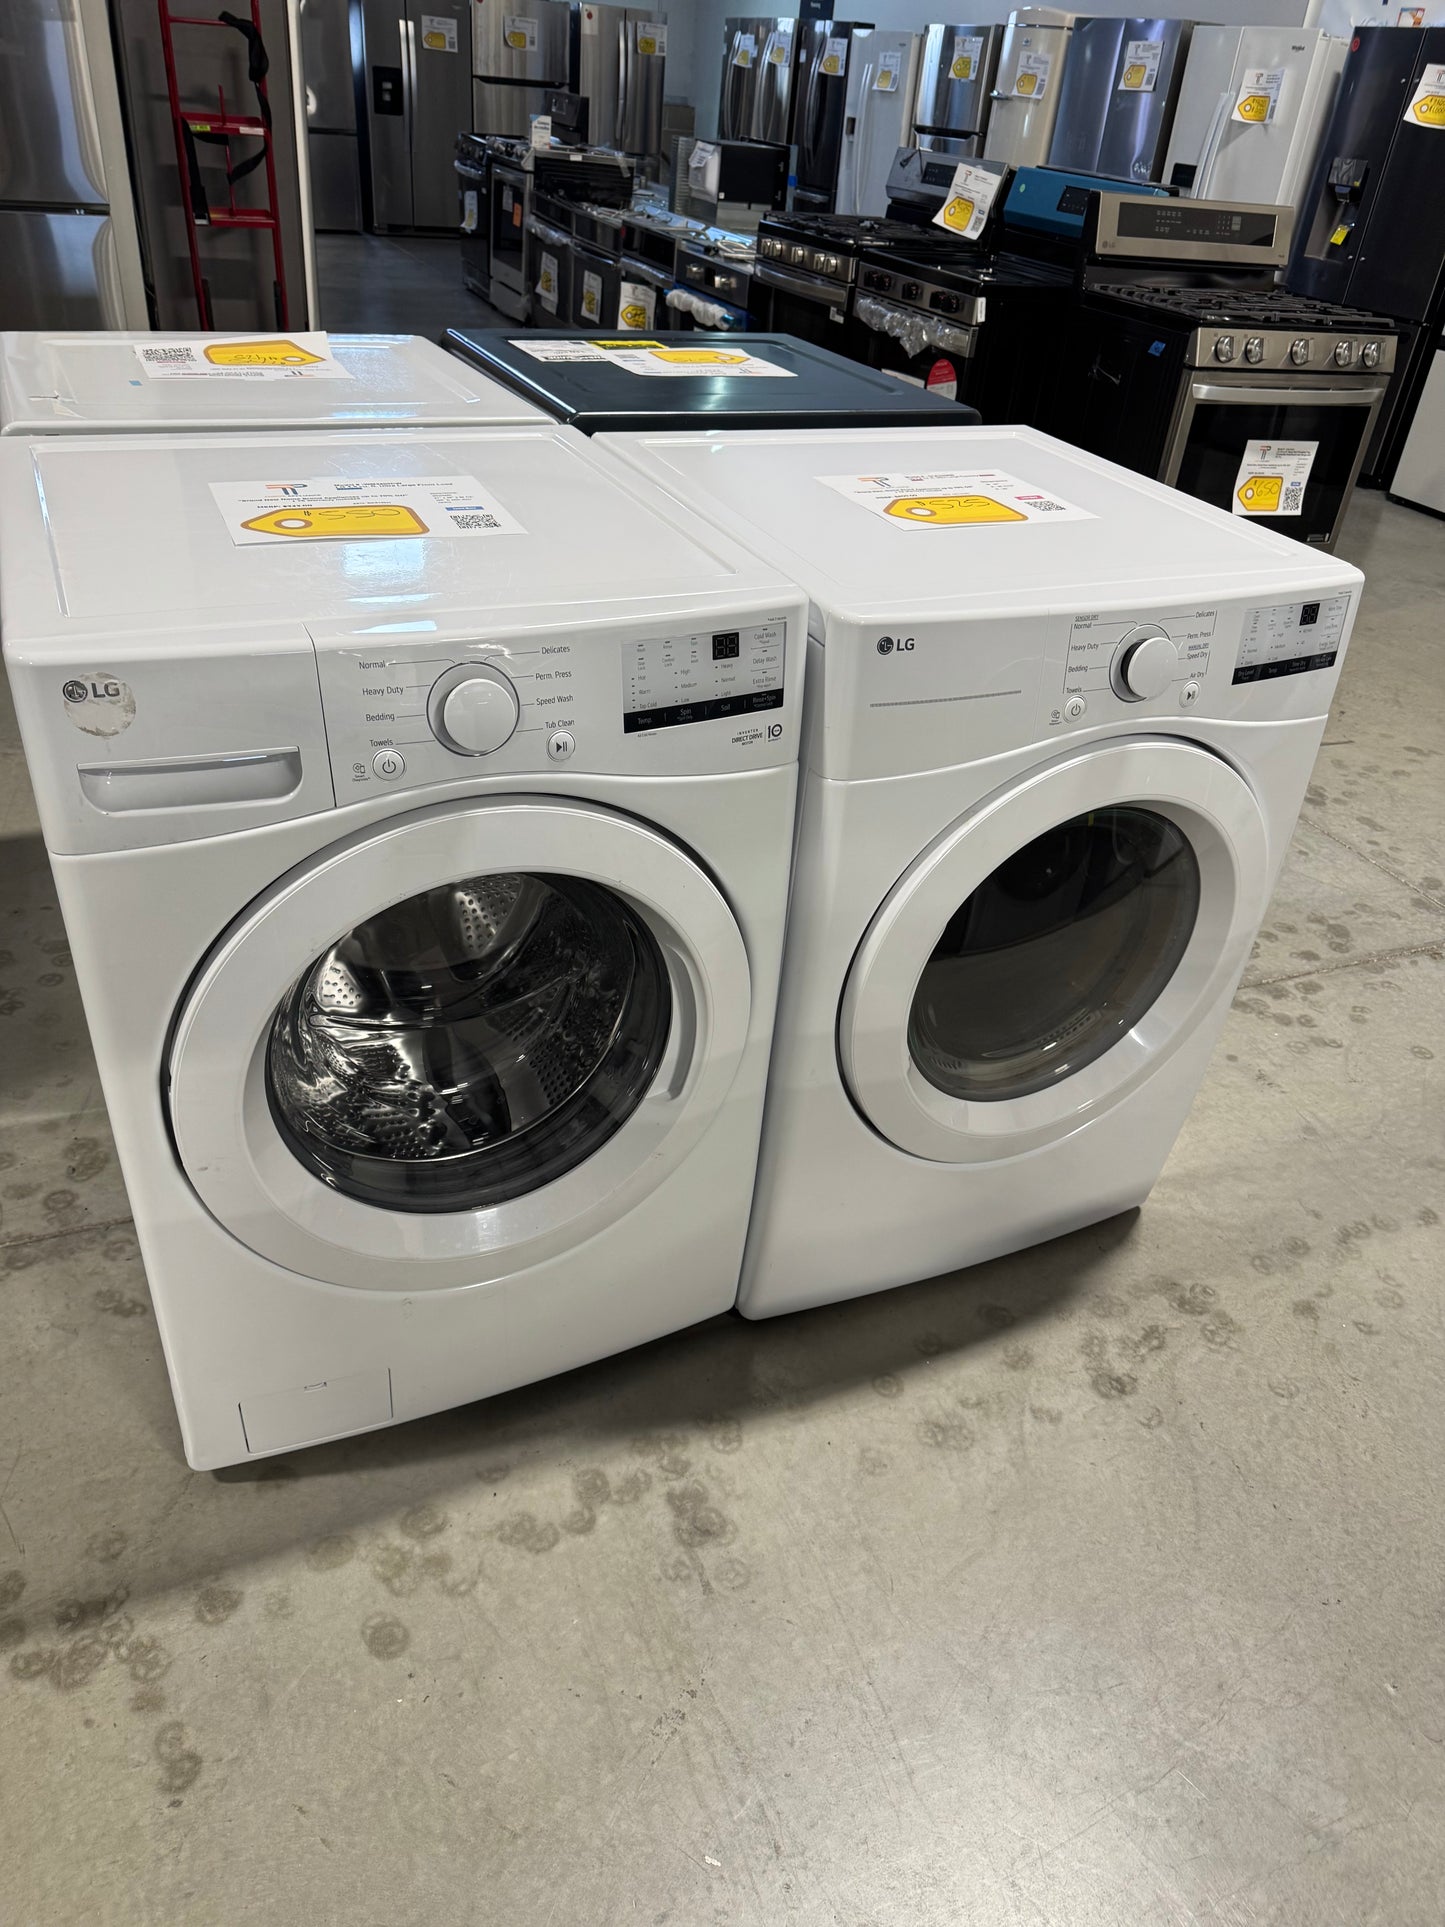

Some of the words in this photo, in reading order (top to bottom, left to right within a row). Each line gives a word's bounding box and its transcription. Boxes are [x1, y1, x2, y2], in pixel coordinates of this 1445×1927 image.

[1195, 610, 1215, 619] Delicates
[1073, 622, 1093, 630] Normal
[896, 637, 916, 652] LG
[1070, 644, 1087, 652] Heavy
[1087, 642, 1100, 651] Duty
[541, 645, 571, 655] Delicates
[358, 660, 386, 669] Normal
[1067, 664, 1089, 673] Bedding
[535, 672, 553, 681] Perm.
[554, 670, 573, 679] Press
[90, 681, 121, 699] LG
[362, 687, 385, 697] Heavy
[386, 686, 404, 695] Duty
[535, 696, 556, 707] Speed
[556, 694, 574, 703] Wash
[365, 712, 395, 722] Bedding
[545, 721, 557, 729] Tub
[557, 719, 575, 728] Clean
[369, 738, 394, 747] Towels
[731, 735, 749, 744] DIRECT
[749, 732, 763, 740] DRIVE
